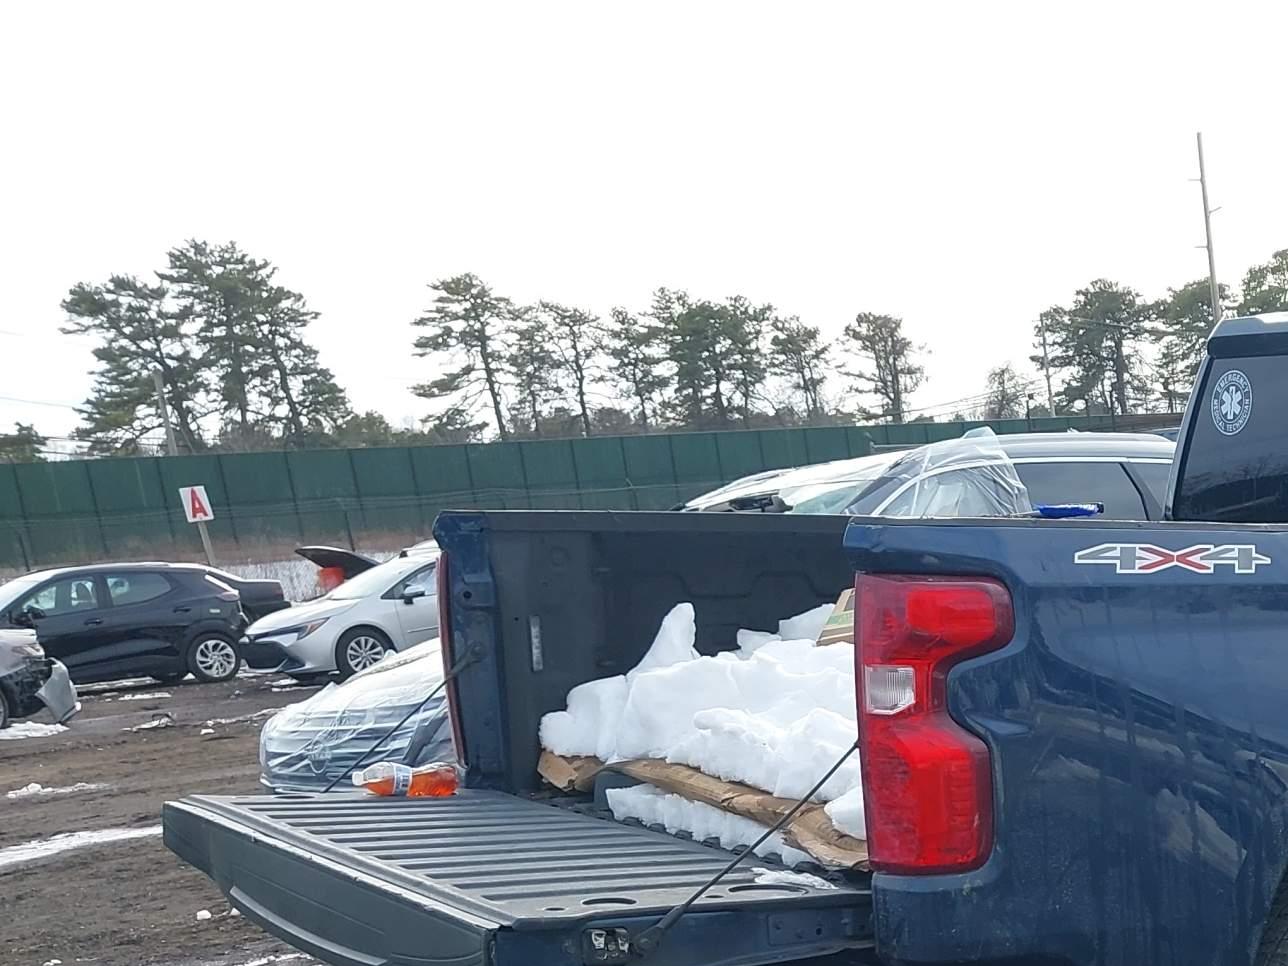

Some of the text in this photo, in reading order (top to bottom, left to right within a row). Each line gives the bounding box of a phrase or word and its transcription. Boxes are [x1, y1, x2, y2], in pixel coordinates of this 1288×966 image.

[1216, 373, 1249, 393] EMERGENCY
[1213, 398, 1225, 430] MEDICAL
[191, 487, 208, 518] A
